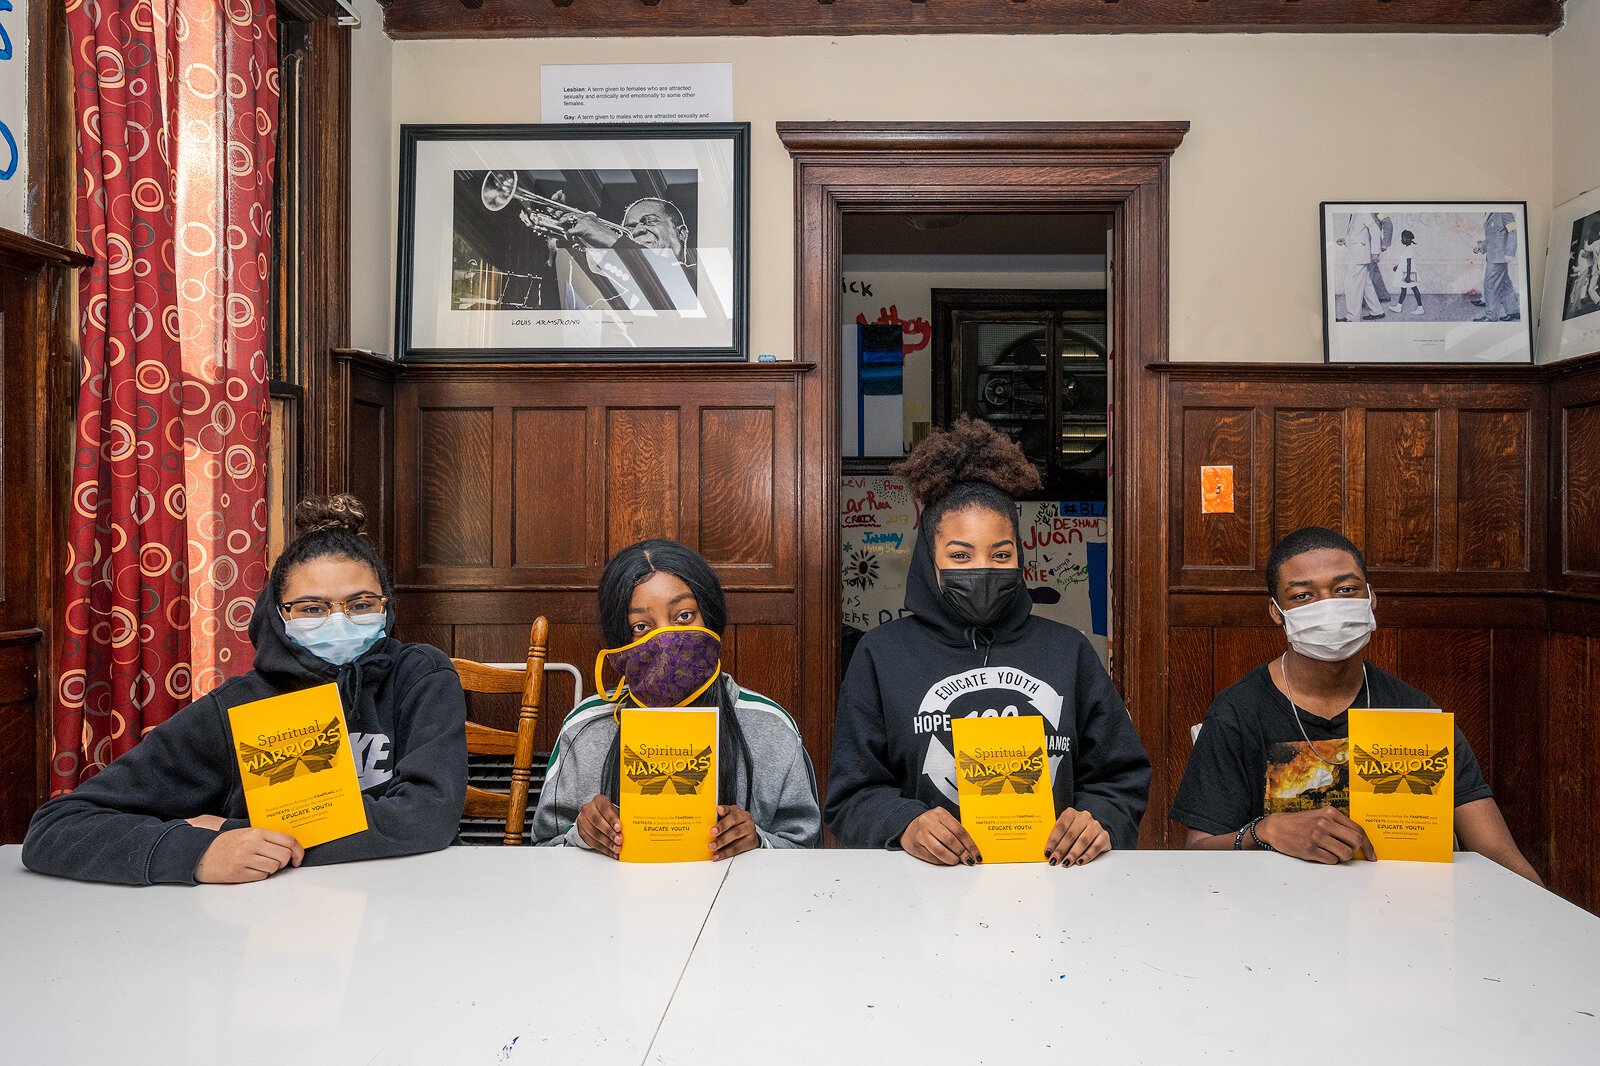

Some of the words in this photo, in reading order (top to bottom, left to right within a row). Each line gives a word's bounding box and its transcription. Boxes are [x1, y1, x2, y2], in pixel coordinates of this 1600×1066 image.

[535, 318, 580, 326] ARMSTRONG
[1023, 526, 1083, 550] Juan
[935, 673, 988, 700] EDUCATE
[998, 672, 1040, 694] YOUTH
[258, 720, 320, 747] Spiritual
[914, 714, 951, 734] HOPE
[243, 728, 341, 771] WARRIORS
[639, 744, 693, 758] Spiritual
[975, 745, 1027, 761] Spiritual
[1372, 743, 1430, 758] Spiritual
[624, 756, 710, 775] WARRIORS
[961, 756, 1044, 779] WARRIORS
[1354, 757, 1448, 775] WARRIORS
[282, 808, 310, 821] EDUCATE
[312, 802, 333, 811] YOUTH
